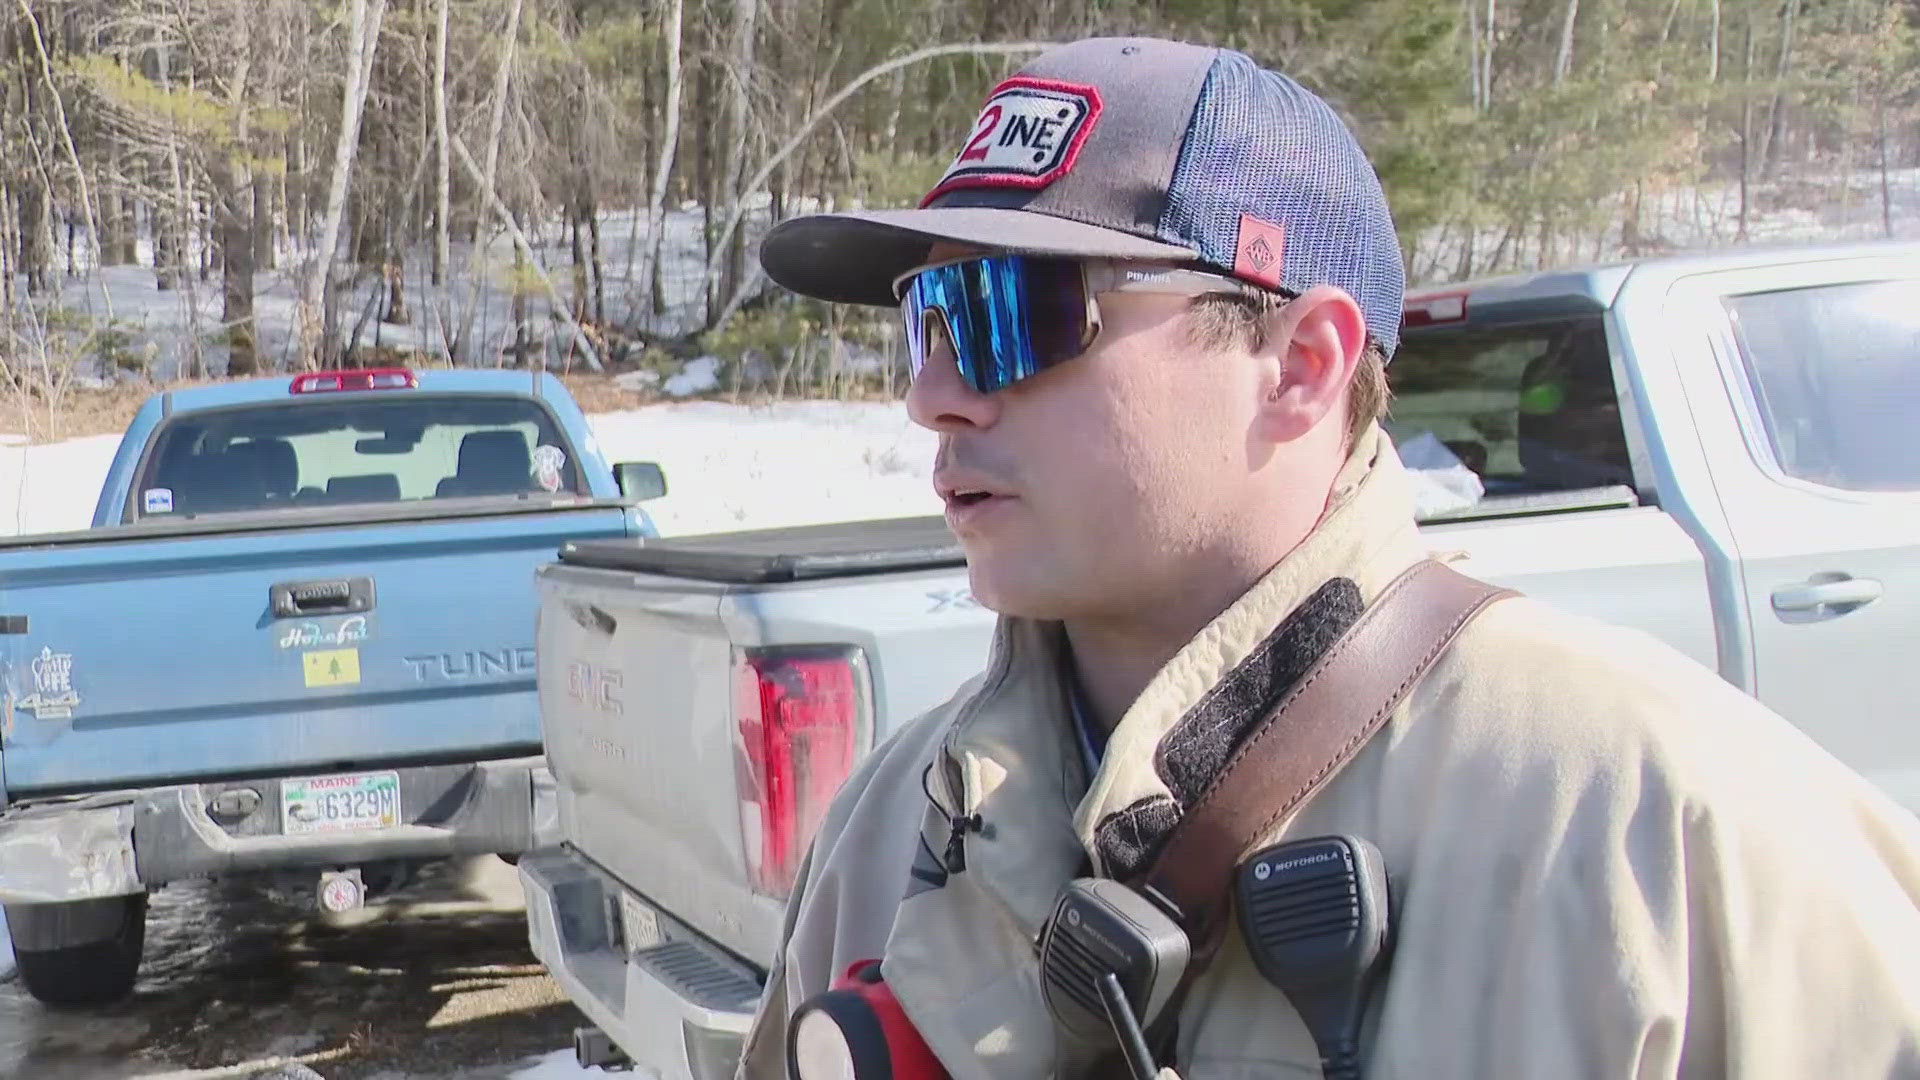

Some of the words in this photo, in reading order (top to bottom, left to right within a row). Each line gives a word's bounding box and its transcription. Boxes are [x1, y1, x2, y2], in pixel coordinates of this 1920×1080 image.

[998, 114, 1063, 151] INE
[1126, 270, 1171, 284] PIRANHA
[310, 776, 362, 790] MAINE
[1274, 851, 1339, 873] MOTOROLA
